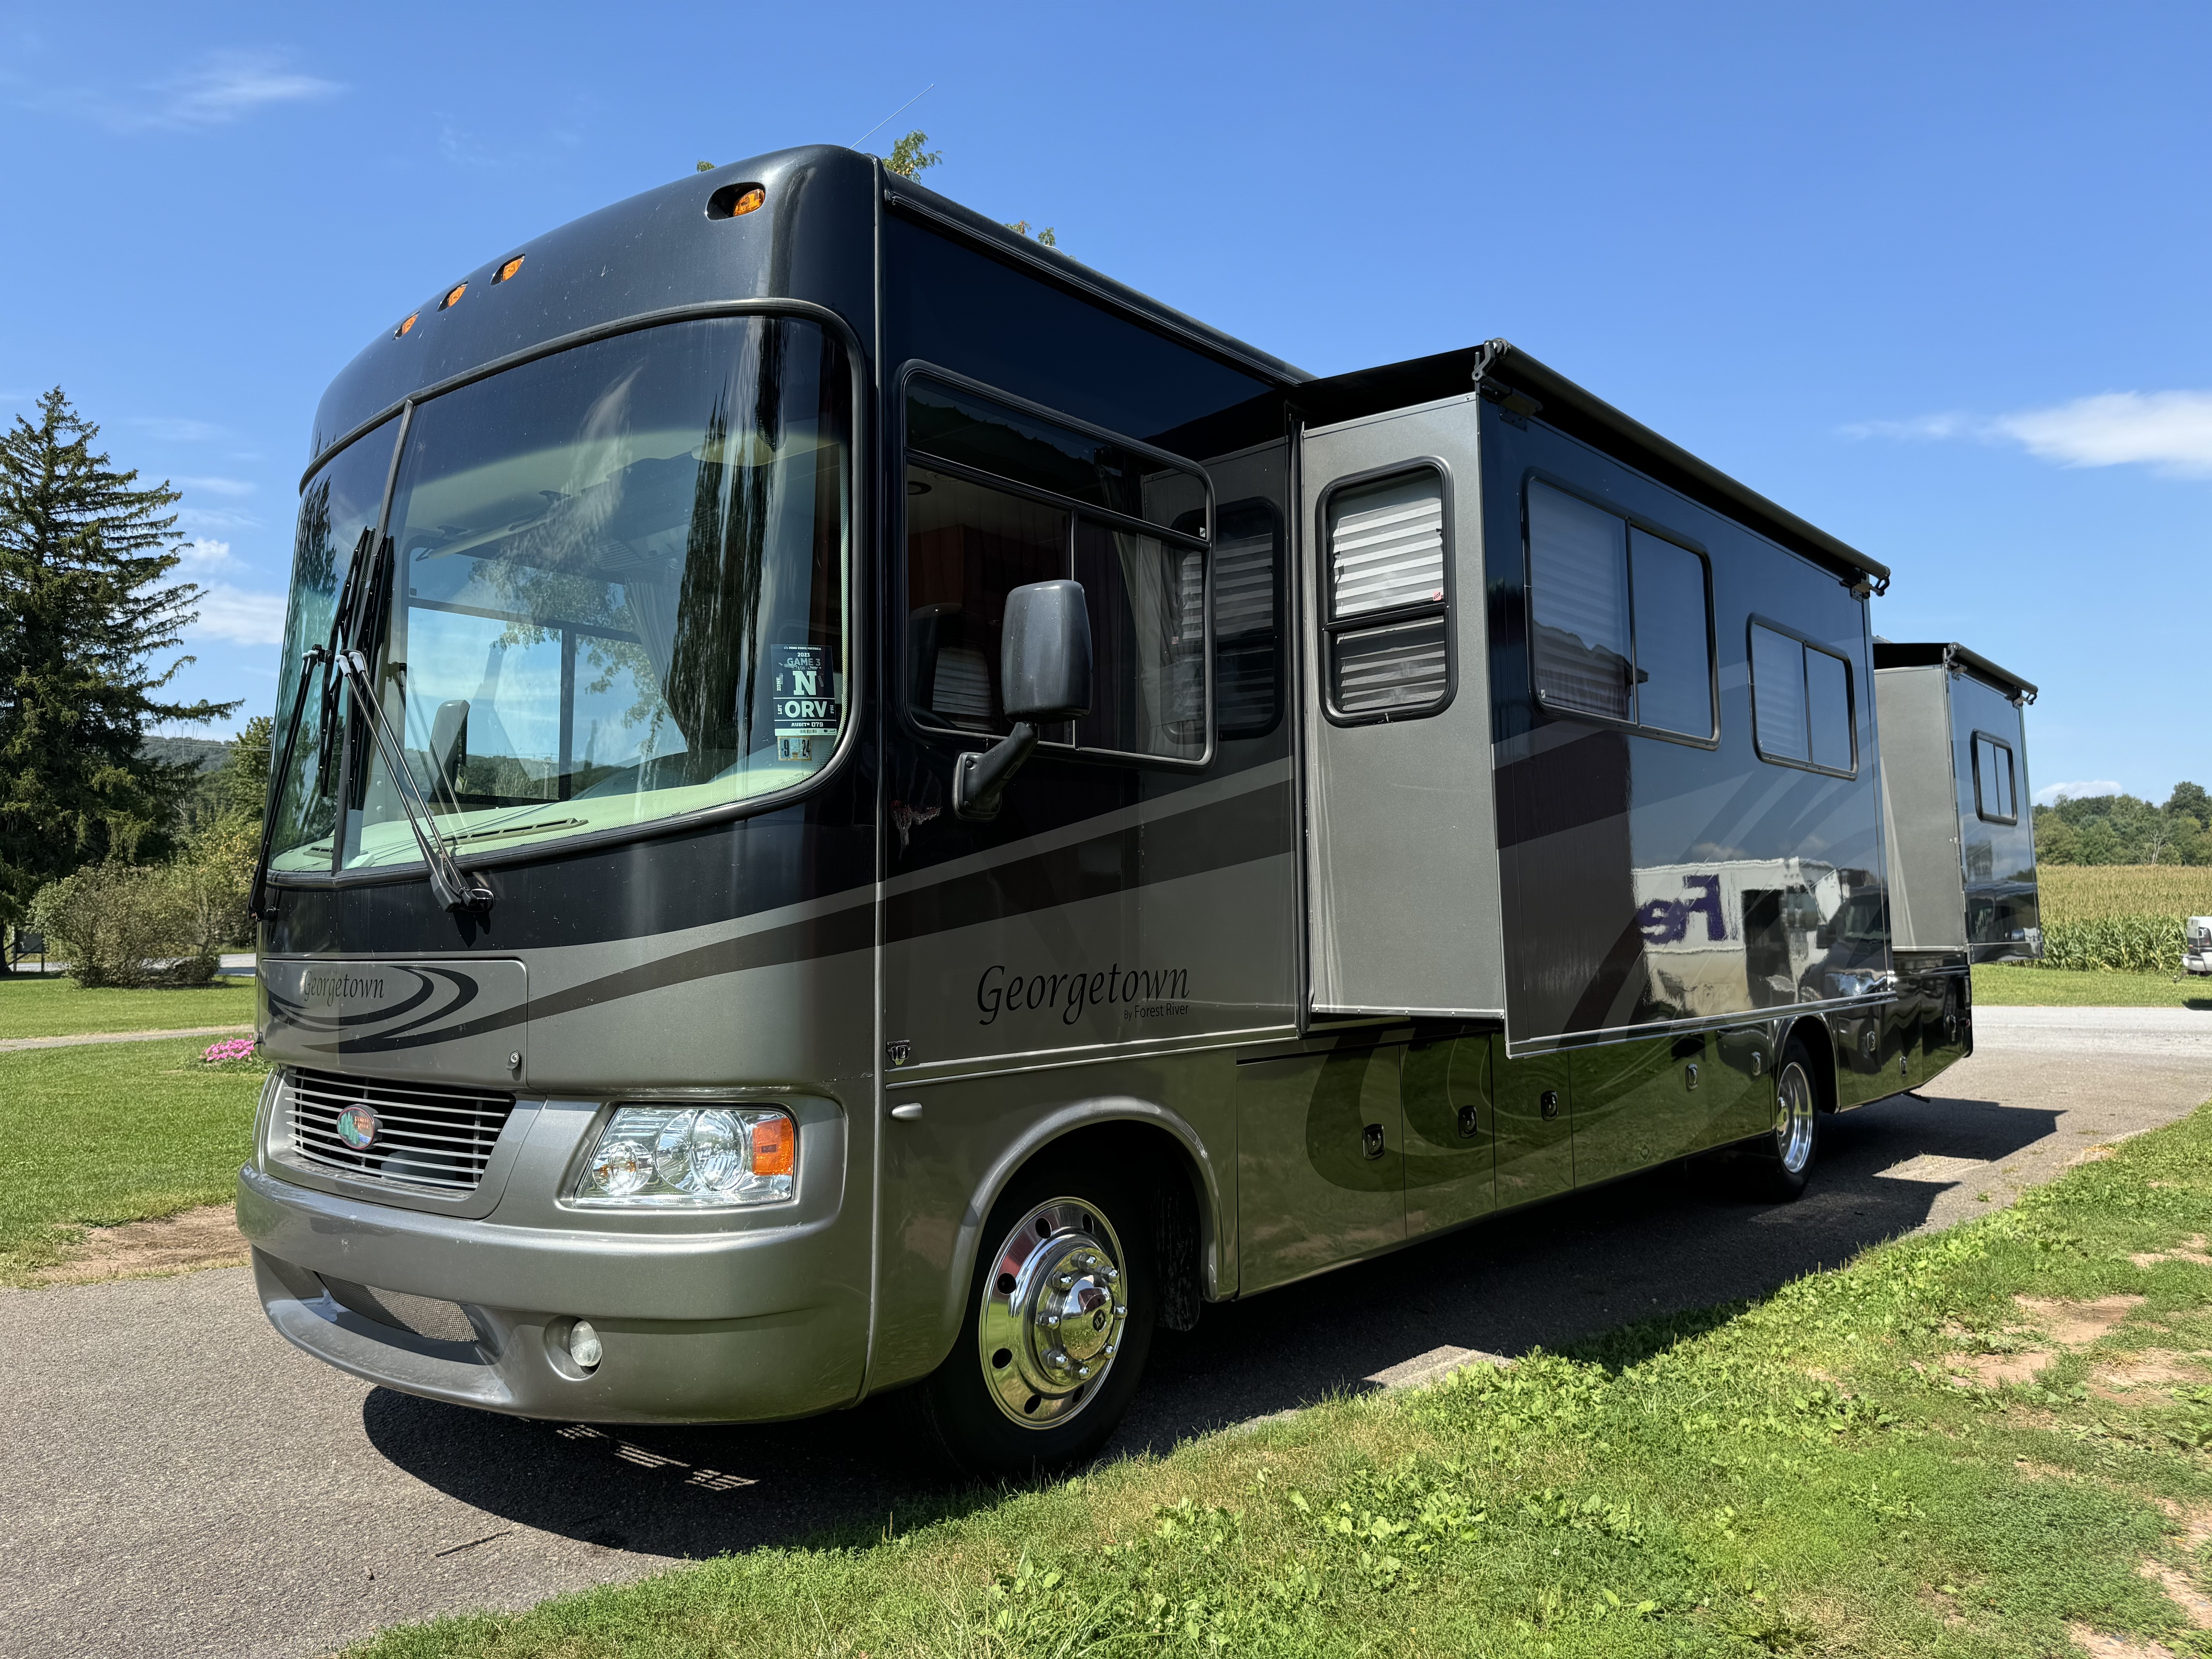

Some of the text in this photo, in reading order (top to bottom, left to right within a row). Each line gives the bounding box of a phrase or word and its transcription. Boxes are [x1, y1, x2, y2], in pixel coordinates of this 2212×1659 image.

[787, 658, 821, 666] GAME 3
[793, 671, 817, 696] N
[785, 701, 828, 718] ORV
[784, 739, 790, 757] 9
[802, 739, 810, 757] 24
[304, 971, 385, 1007] Georgetown
[977, 963, 1190, 1025] Georgetown
[1124, 1002, 1189, 1021] By Forest River
